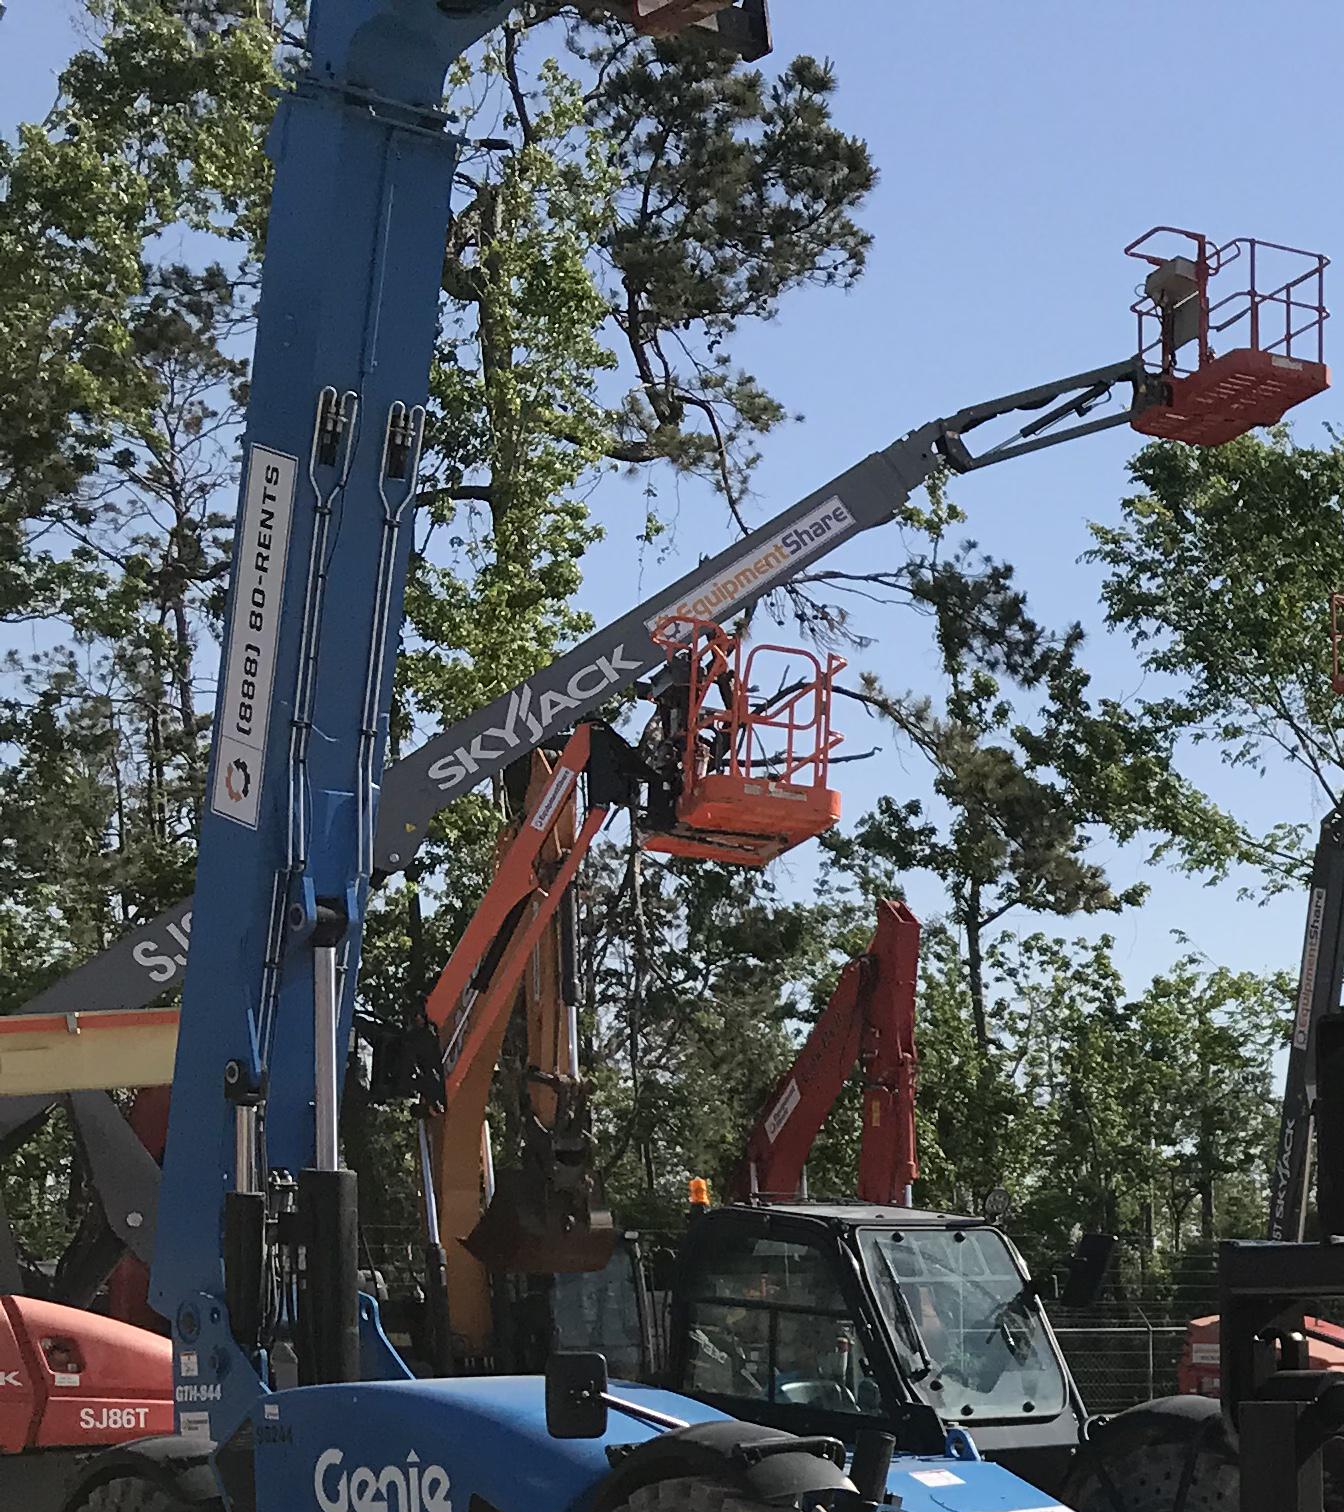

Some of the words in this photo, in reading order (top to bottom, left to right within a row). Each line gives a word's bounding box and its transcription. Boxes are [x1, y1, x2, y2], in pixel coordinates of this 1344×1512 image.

[237, 643, 261, 736] (888)
[249, 464, 281, 632] 80-RENTS
[677, 506, 848, 617] EquipmentShare
[428, 643, 644, 790] SKYJACK
[1275, 1118, 1296, 1218] SKYJACK
[80, 1408, 149, 1429] SJ86T
